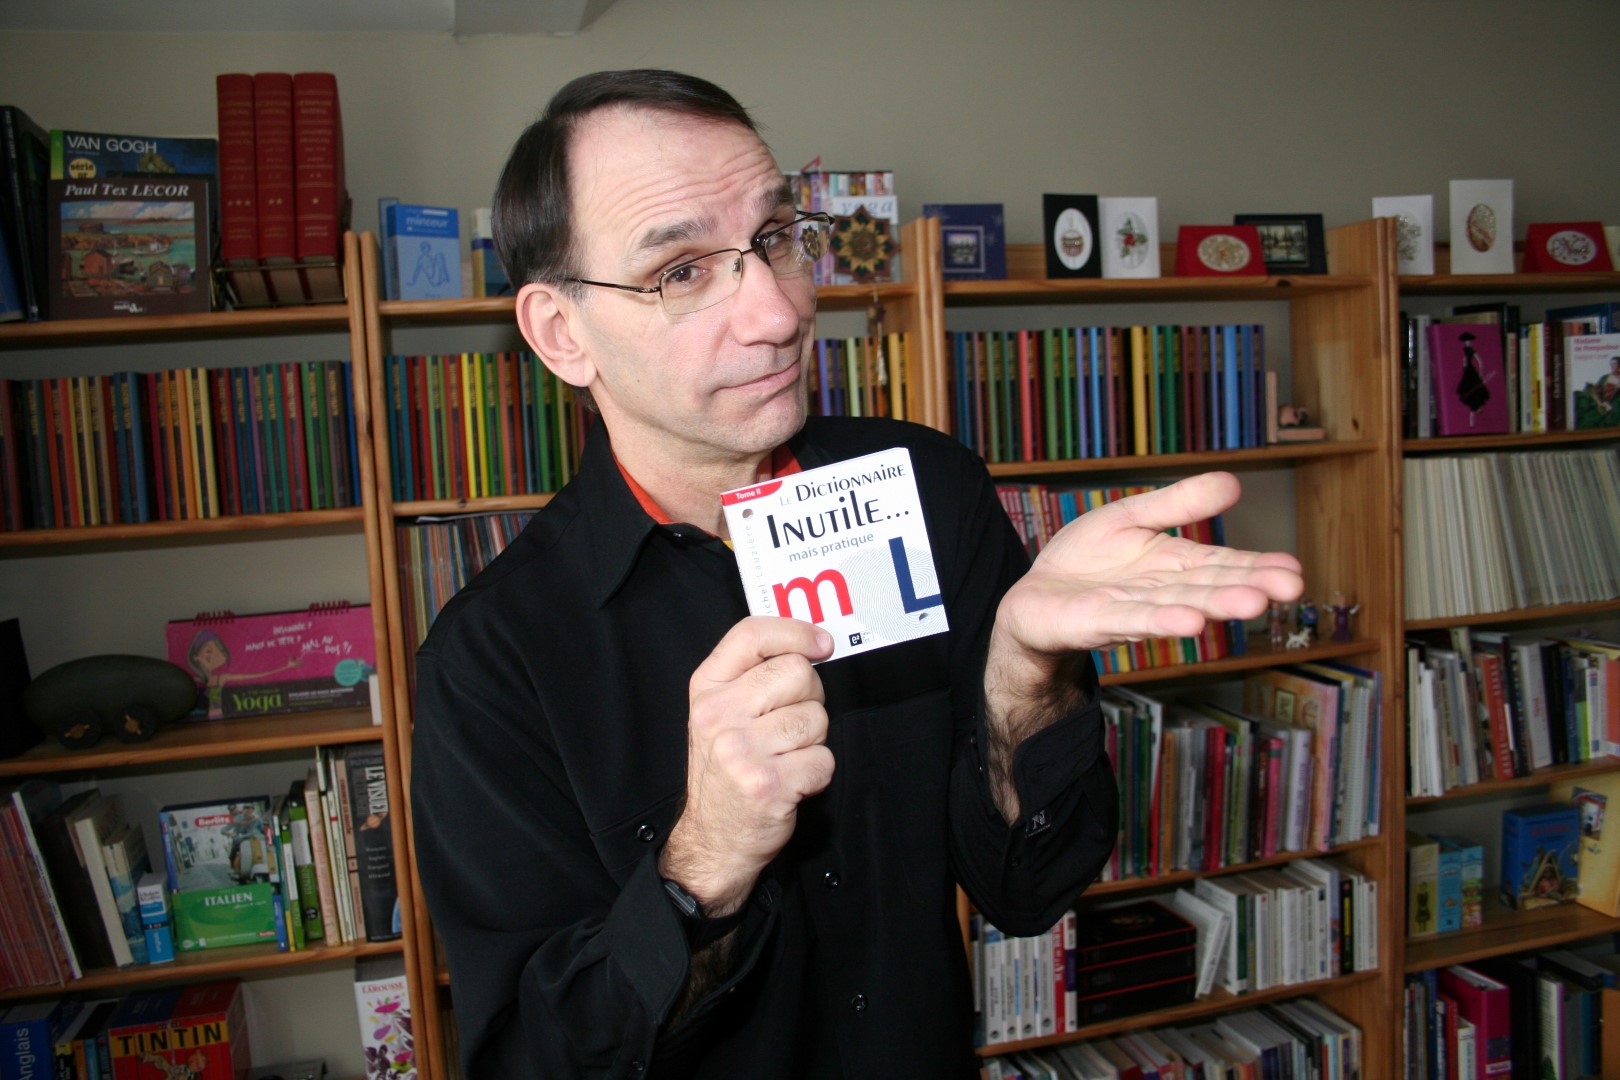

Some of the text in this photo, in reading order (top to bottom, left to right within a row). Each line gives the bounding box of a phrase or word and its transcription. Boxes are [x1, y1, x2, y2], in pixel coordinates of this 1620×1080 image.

[67, 135, 101, 150] VAN
[106, 139, 157, 153] GOGH
[65, 183, 189, 197] Paul Tex LECOR
[735, 487, 762, 500] Tome II
[789, 532, 875, 562] mais pratique
[232, 692, 283, 713] Yoga
[365, 766, 386, 781] LE
[366, 780, 389, 815] VISUEL
[199, 816, 231, 827] Berlitz
[204, 892, 253, 908] ITALIEN
[361, 982, 403, 994] LAROUSSE
[117, 1022, 222, 1056] TINTIN
